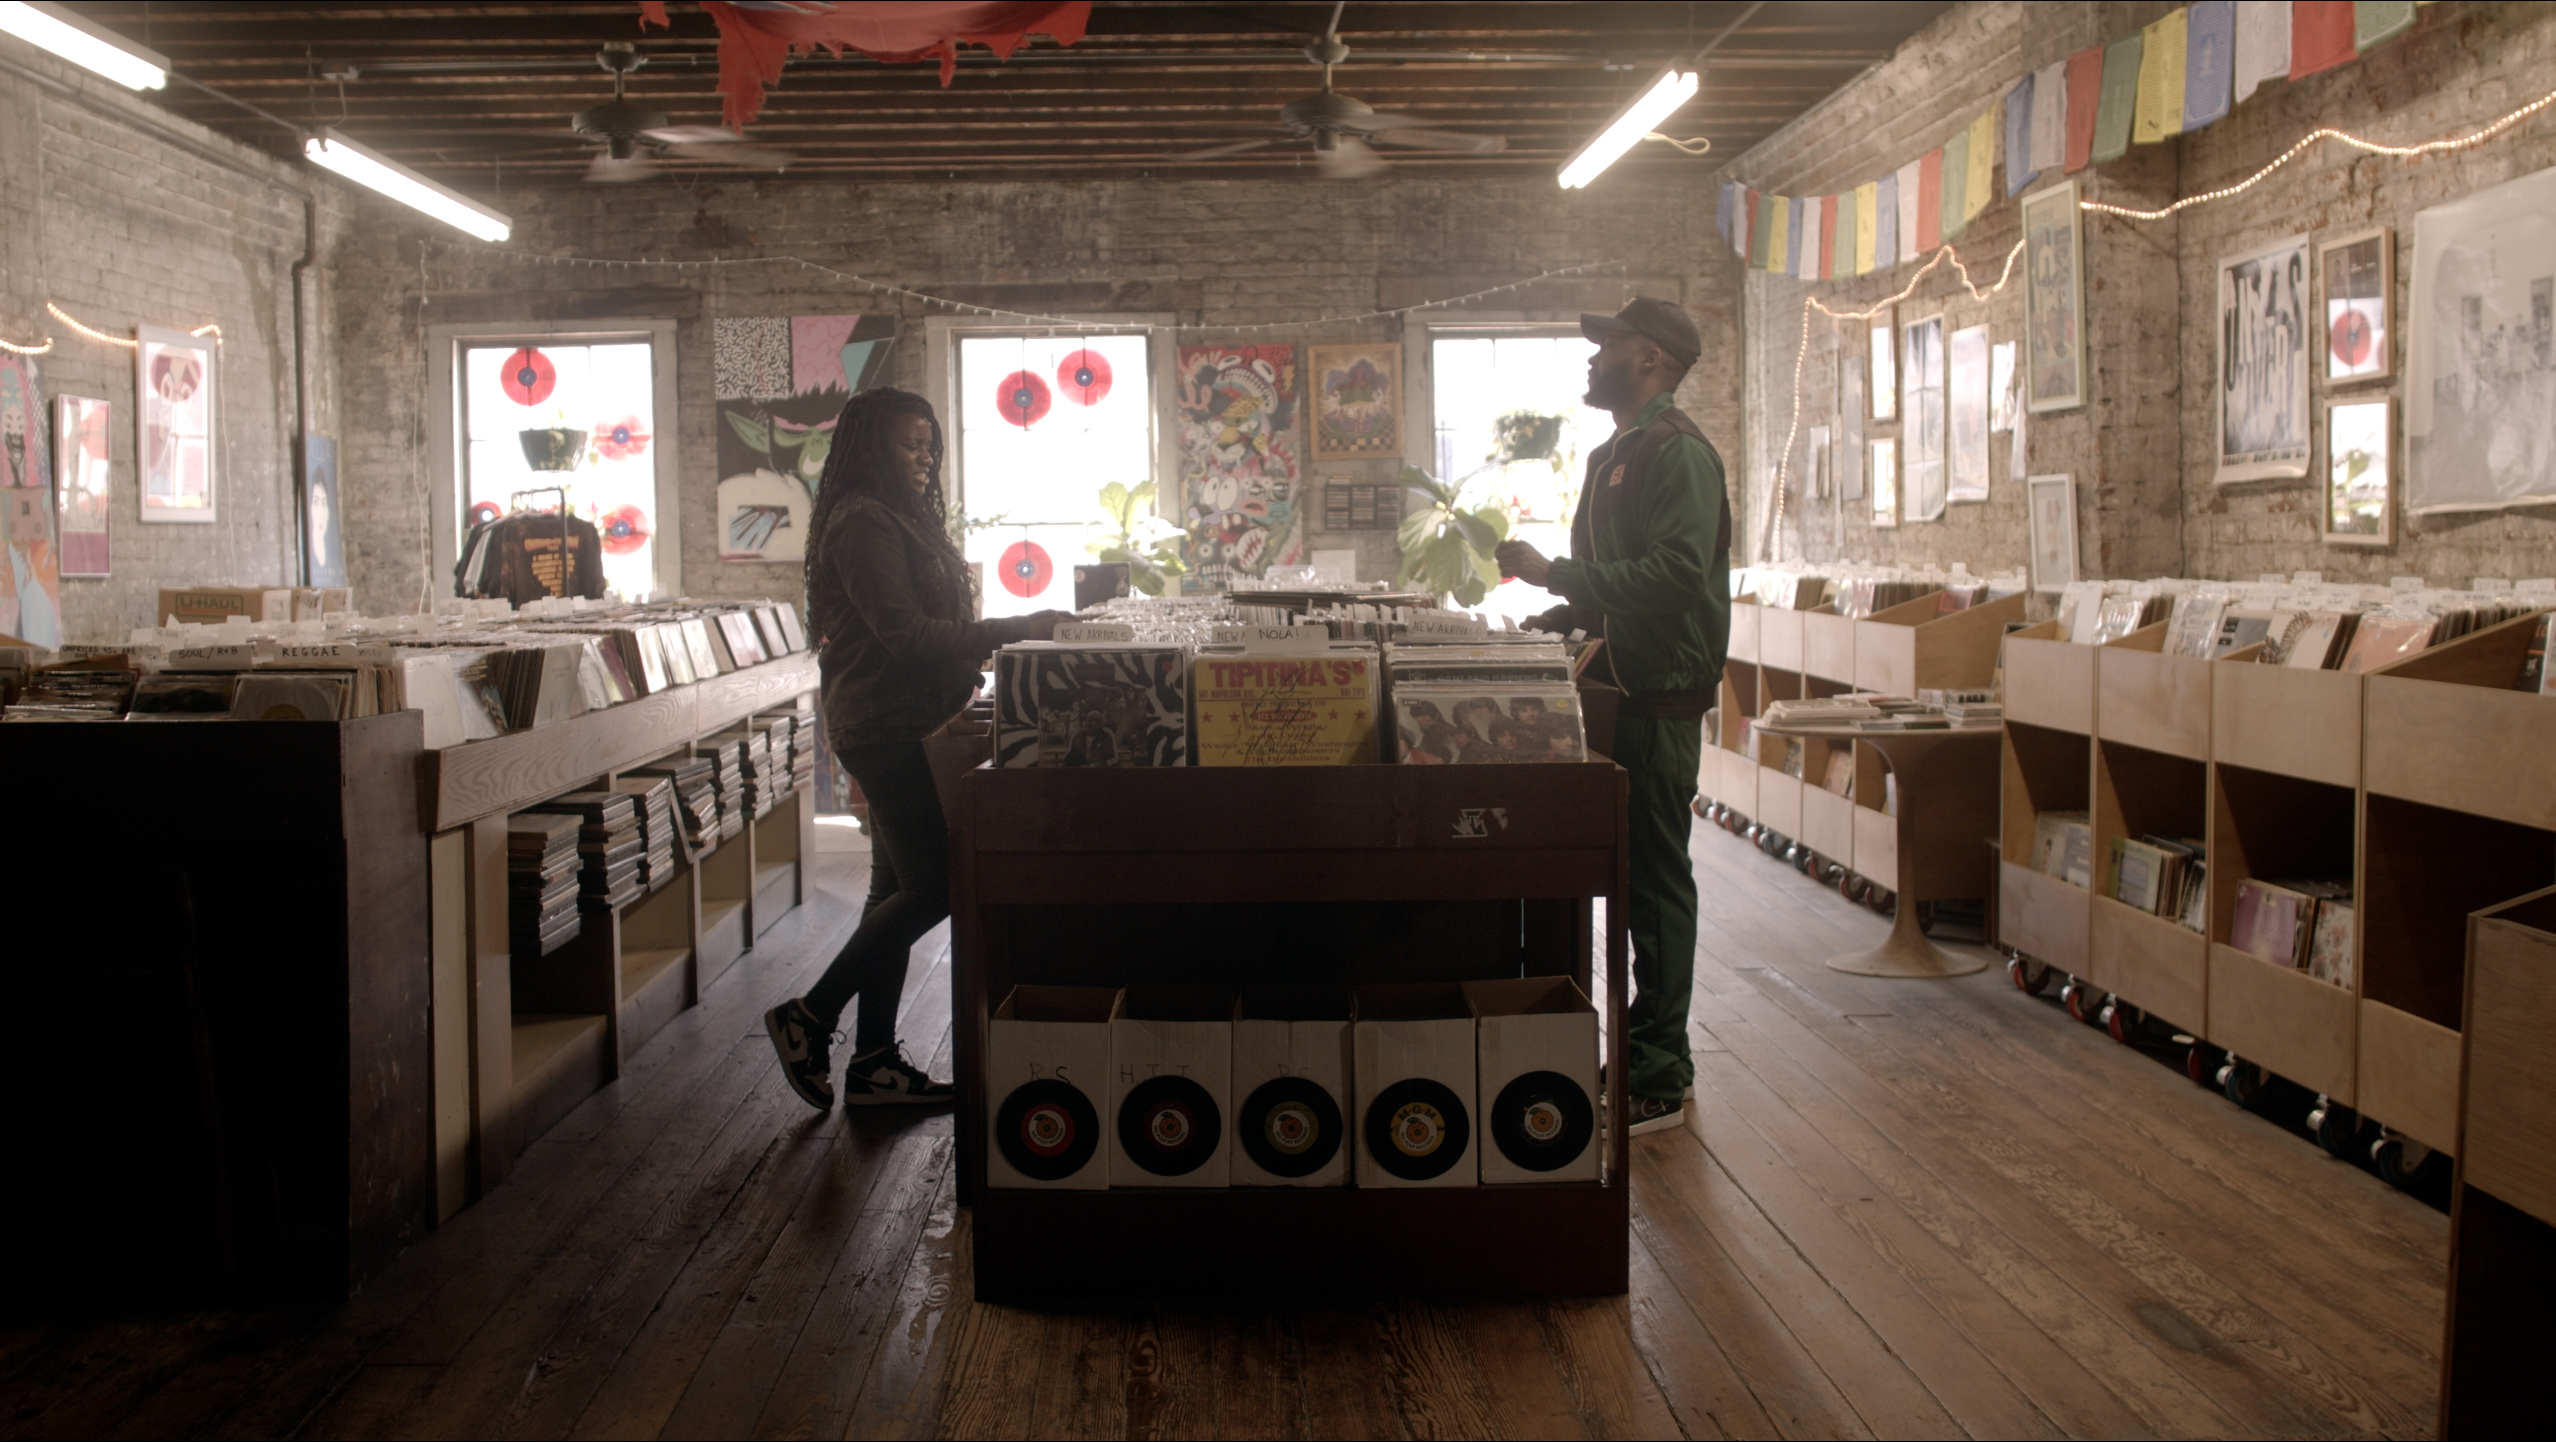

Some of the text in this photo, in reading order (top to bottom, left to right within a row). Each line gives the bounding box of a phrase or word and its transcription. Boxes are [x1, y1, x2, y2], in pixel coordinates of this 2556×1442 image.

[1061, 628, 1129, 641] NEW ARRIVALS
[1258, 628, 1300, 641] NOLA!
[1413, 621, 1483, 635] NEW ARRIVALS
[1217, 629, 1238, 641] NEW
[62, 645, 99, 653] UNPRICED
[282, 646, 341, 657] REGGAE
[1208, 660, 1352, 688] TIPITINA'S
[1210, 689, 1242, 698] NAPOLEON
[1545, 1118, 1560, 1137] RECORDS
[1048, 1127, 1065, 1144] RECORDS
[1156, 1133, 1167, 1142] PULP
[1166, 1131, 1187, 1144] RECORDS
[1294, 1126, 1309, 1144] RECORDS
[1404, 1139, 1416, 1149] PULP
[1415, 1135, 1435, 1150] RECORDS
